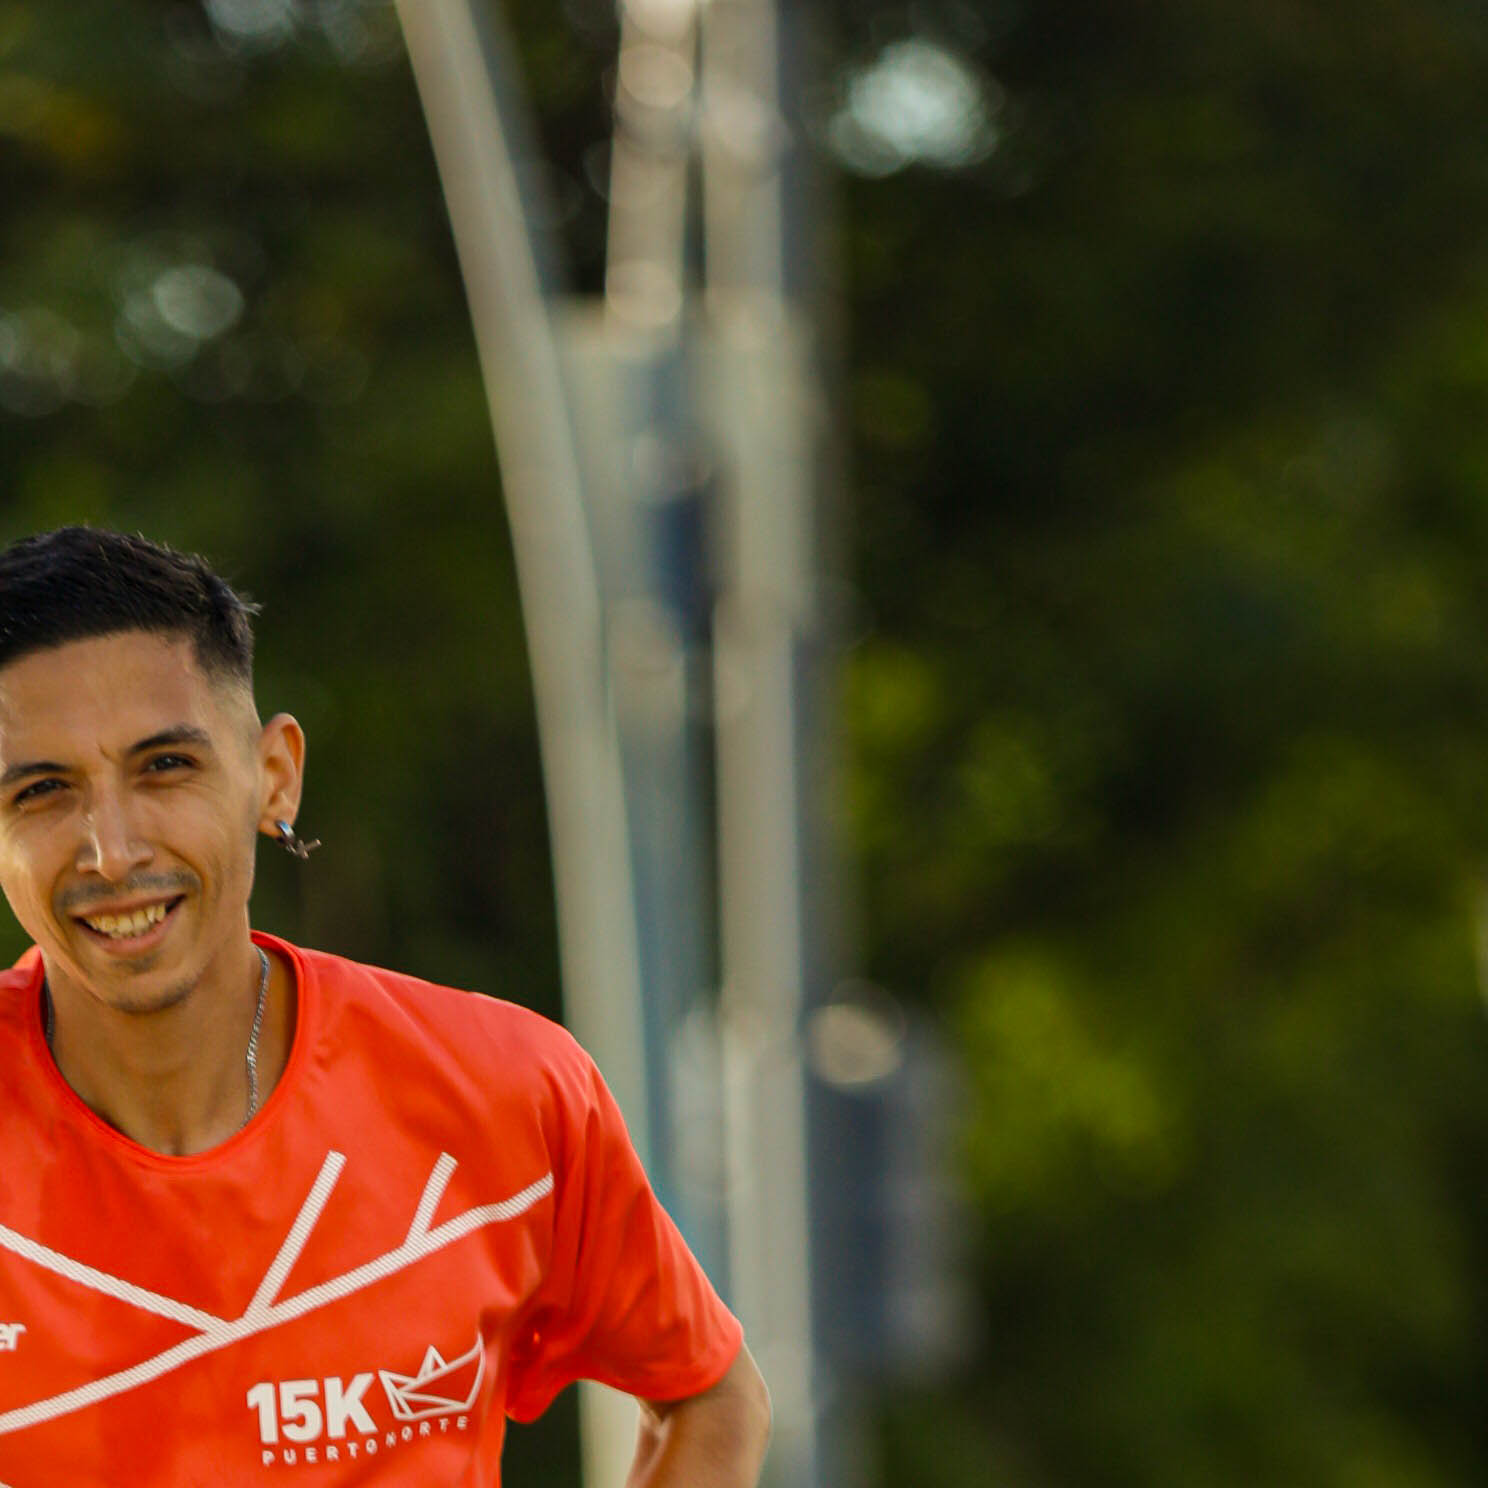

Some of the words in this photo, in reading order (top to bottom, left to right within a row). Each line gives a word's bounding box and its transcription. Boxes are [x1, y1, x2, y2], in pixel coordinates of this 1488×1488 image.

[246, 1372, 378, 1444] 15K
[262, 1438, 378, 1467] PUERTO
[385, 1415, 468, 1448] NORTE
